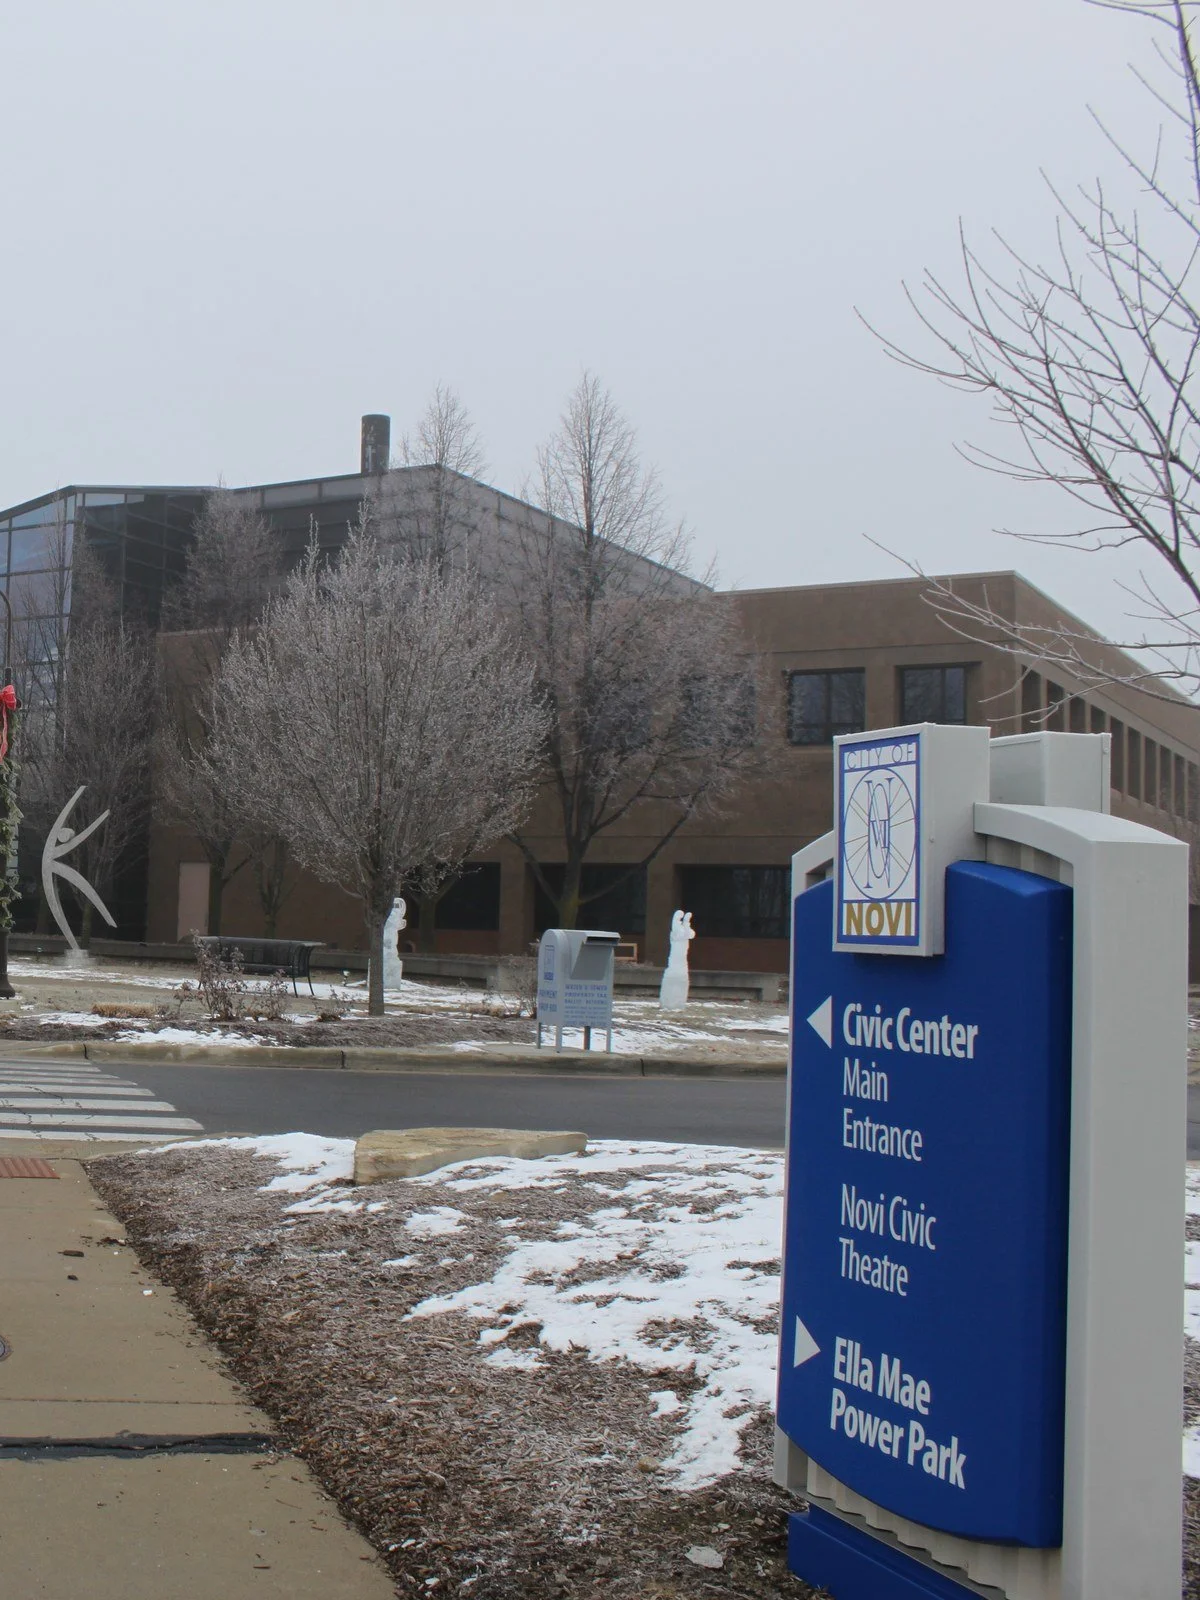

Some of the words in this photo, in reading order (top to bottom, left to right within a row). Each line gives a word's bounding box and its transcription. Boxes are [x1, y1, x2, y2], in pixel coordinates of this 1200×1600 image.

[846, 747, 883, 769] CITY
[891, 743, 914, 763] OF
[846, 902, 912, 936] NOVI
[842, 1002, 893, 1050] Civic
[896, 1007, 979, 1060] Center
[842, 1057, 888, 1102] Main
[842, 1108, 923, 1162] Entrance
[841, 1183, 885, 1236] Novi
[888, 1196, 937, 1250] Civic
[838, 1237, 909, 1297] Theatre
[833, 1336, 874, 1393] Ella
[877, 1353, 931, 1416] Mae
[830, 1387, 904, 1459] Power
[907, 1420, 967, 1490] Park
